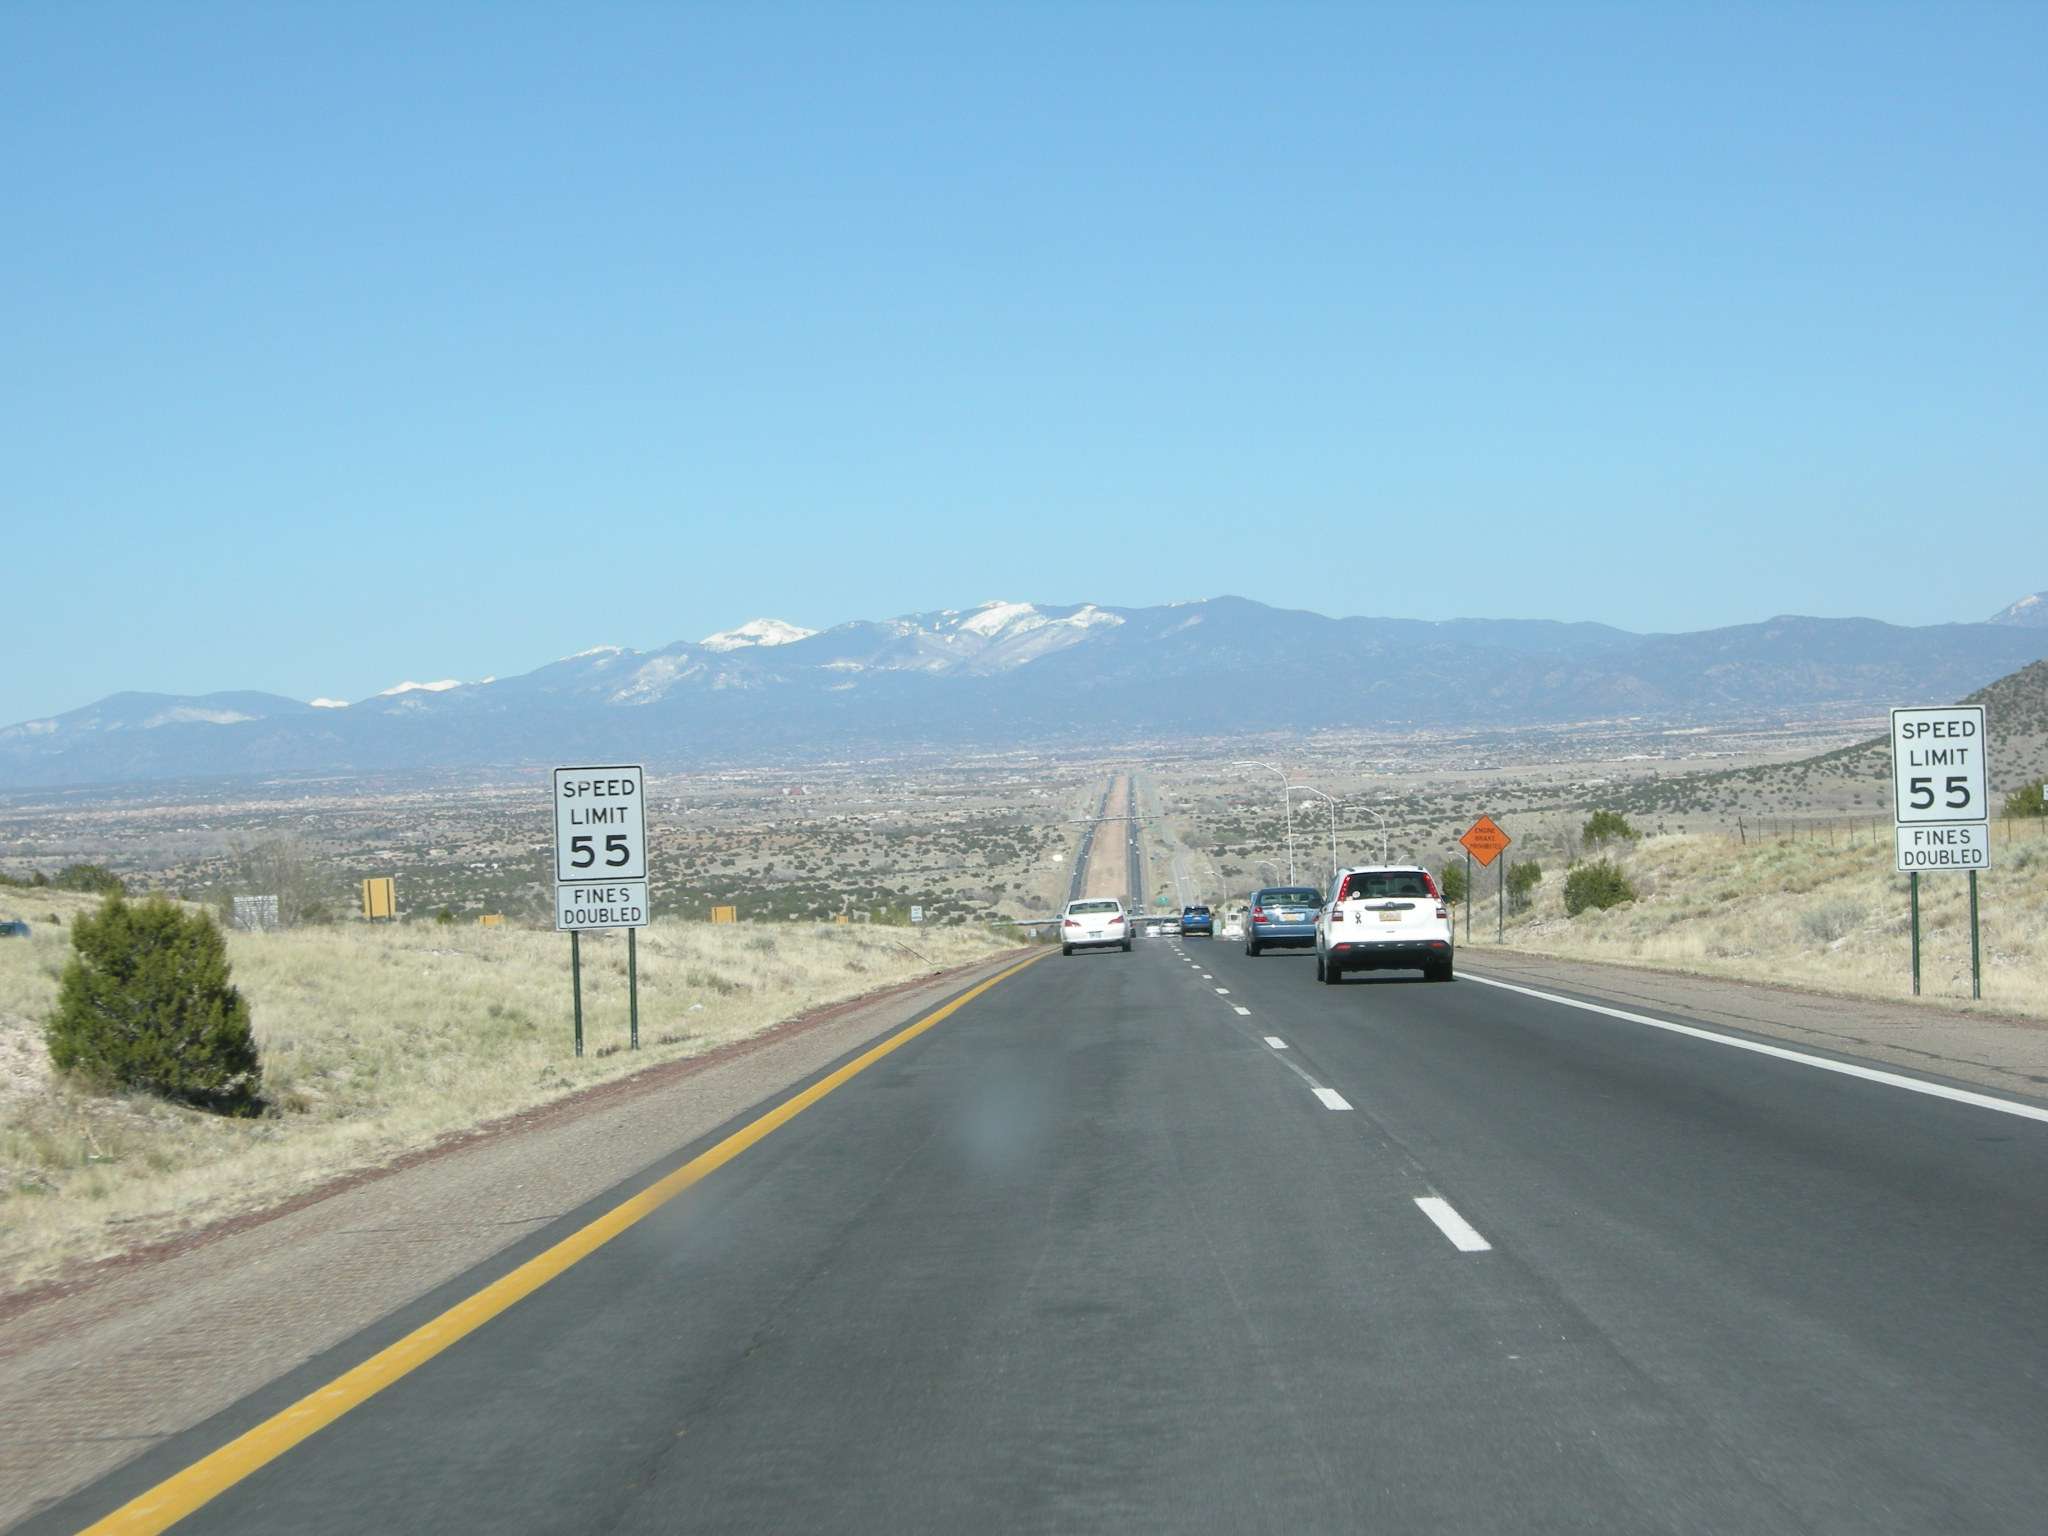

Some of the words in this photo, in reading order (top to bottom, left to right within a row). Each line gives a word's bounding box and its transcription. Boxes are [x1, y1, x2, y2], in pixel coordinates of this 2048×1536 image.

[1902, 721, 1976, 739] SPEED
[1910, 748, 1969, 766] LIMIT
[563, 779, 635, 798] SPEED
[1910, 776, 1971, 809] 55
[571, 807, 629, 825] LIMIT
[1914, 829, 1971, 845] FINES
[571, 834, 630, 868] 55
[1904, 848, 1982, 866] DOUBLED
[574, 887, 631, 904] FINES
[564, 907, 641, 924] DOUBLED
